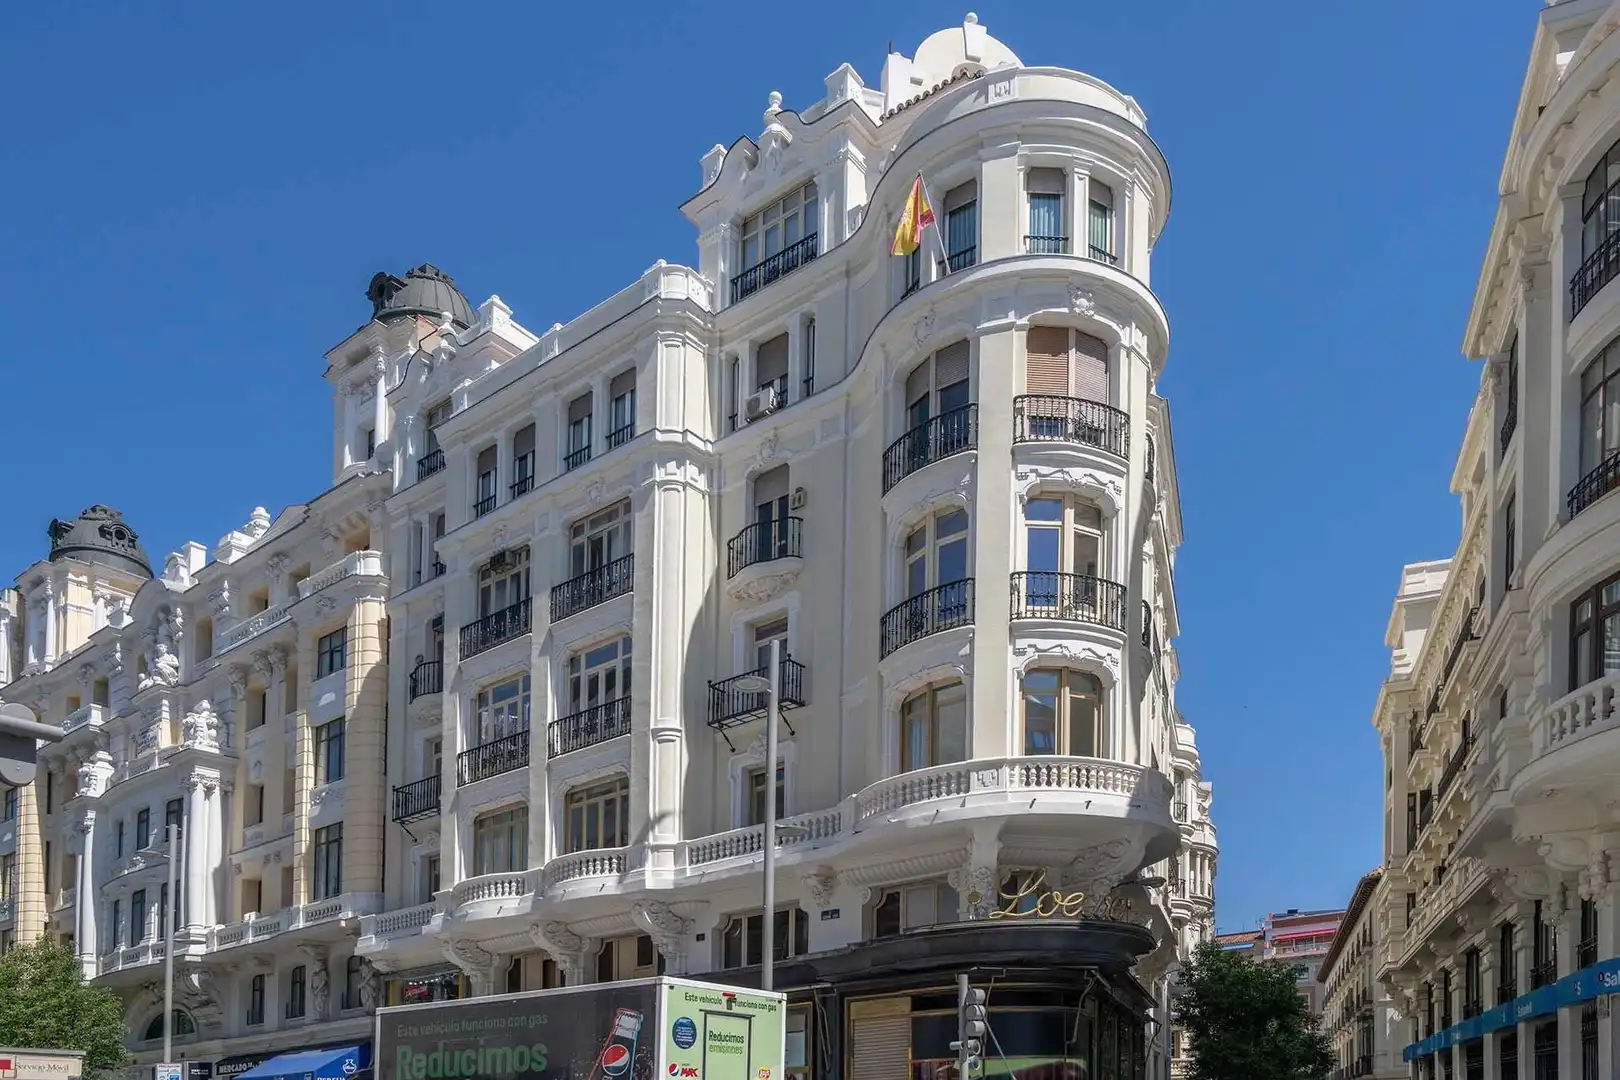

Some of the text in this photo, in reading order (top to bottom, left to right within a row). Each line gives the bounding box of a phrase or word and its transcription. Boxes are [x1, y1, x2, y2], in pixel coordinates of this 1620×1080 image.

[684, 992, 698, 1002] Este
[758, 1002, 767, 1010] con
[768, 1004, 777, 1013] gas
[397, 1024, 418, 1038] Este
[461, 1015, 506, 1033] funciona
[507, 1014, 527, 1028] con
[528, 1013, 549, 1029] gas
[708, 1030, 744, 1044] Reducimos
[395, 1037, 548, 1080] Reducimos
